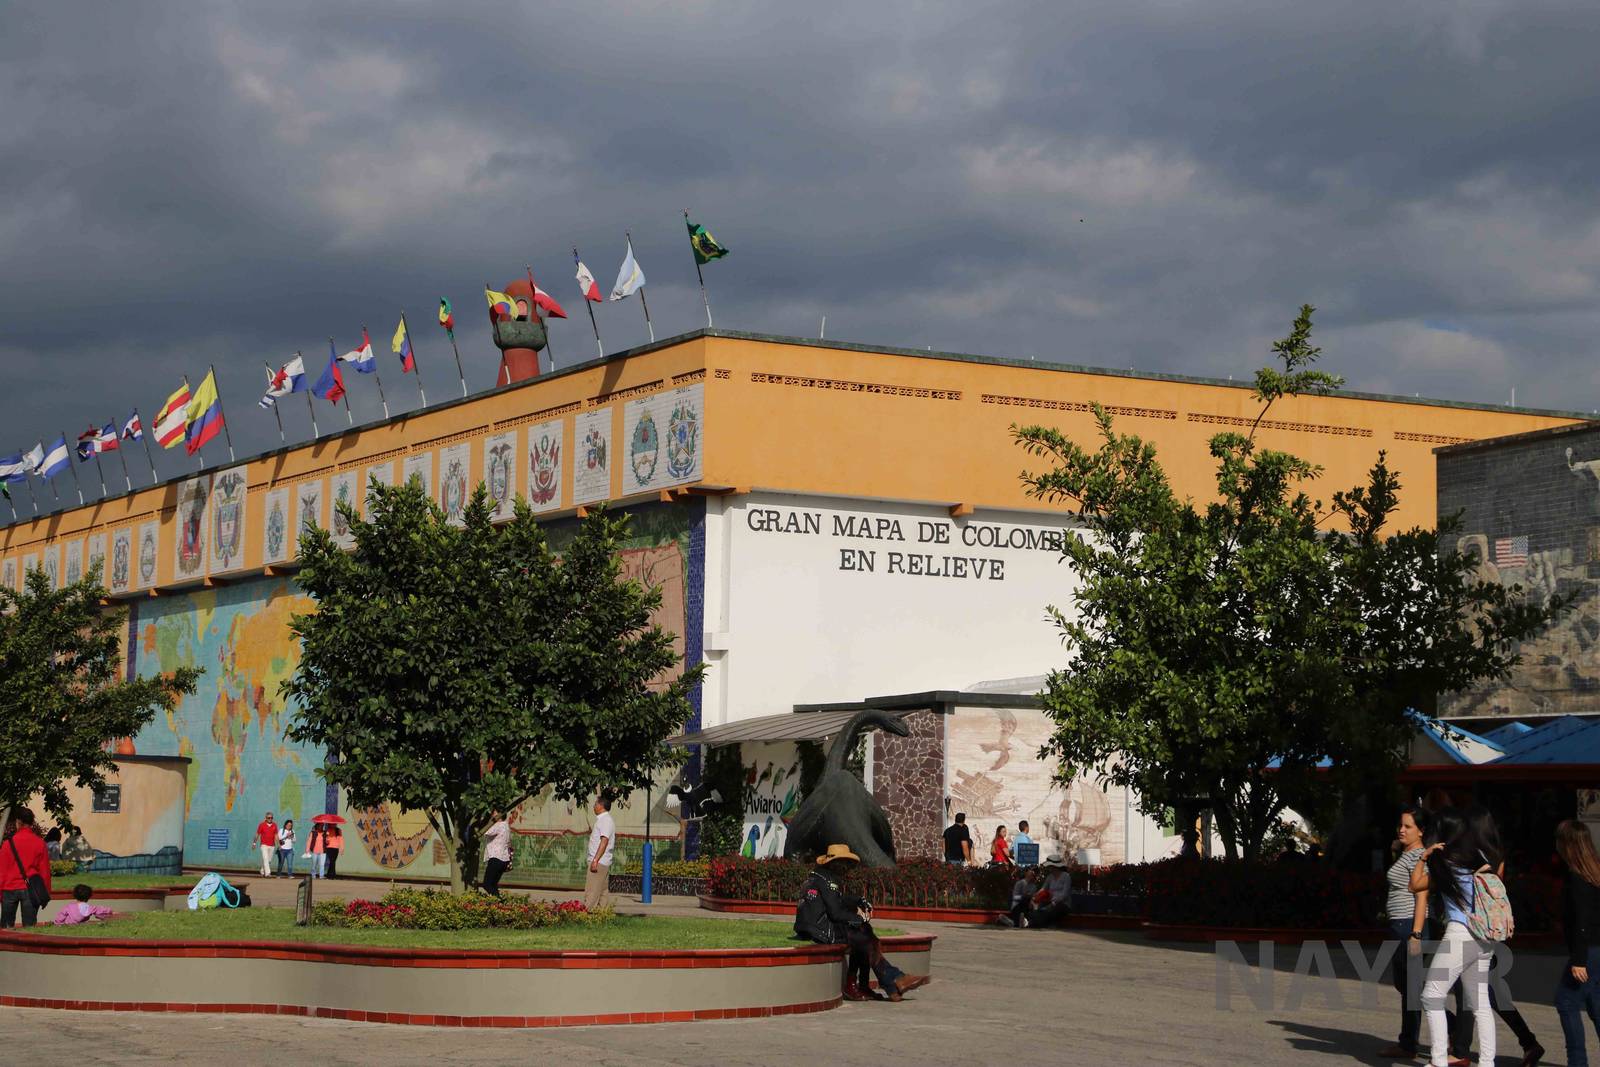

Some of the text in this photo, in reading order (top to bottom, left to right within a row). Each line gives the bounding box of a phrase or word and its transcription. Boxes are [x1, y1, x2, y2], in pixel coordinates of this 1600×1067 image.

[747, 509, 1085, 552] GRAN MAPA DE COLOMBA
[839, 549, 1005, 581] EN RELIEVE
[744, 791, 783, 815] Aviario
